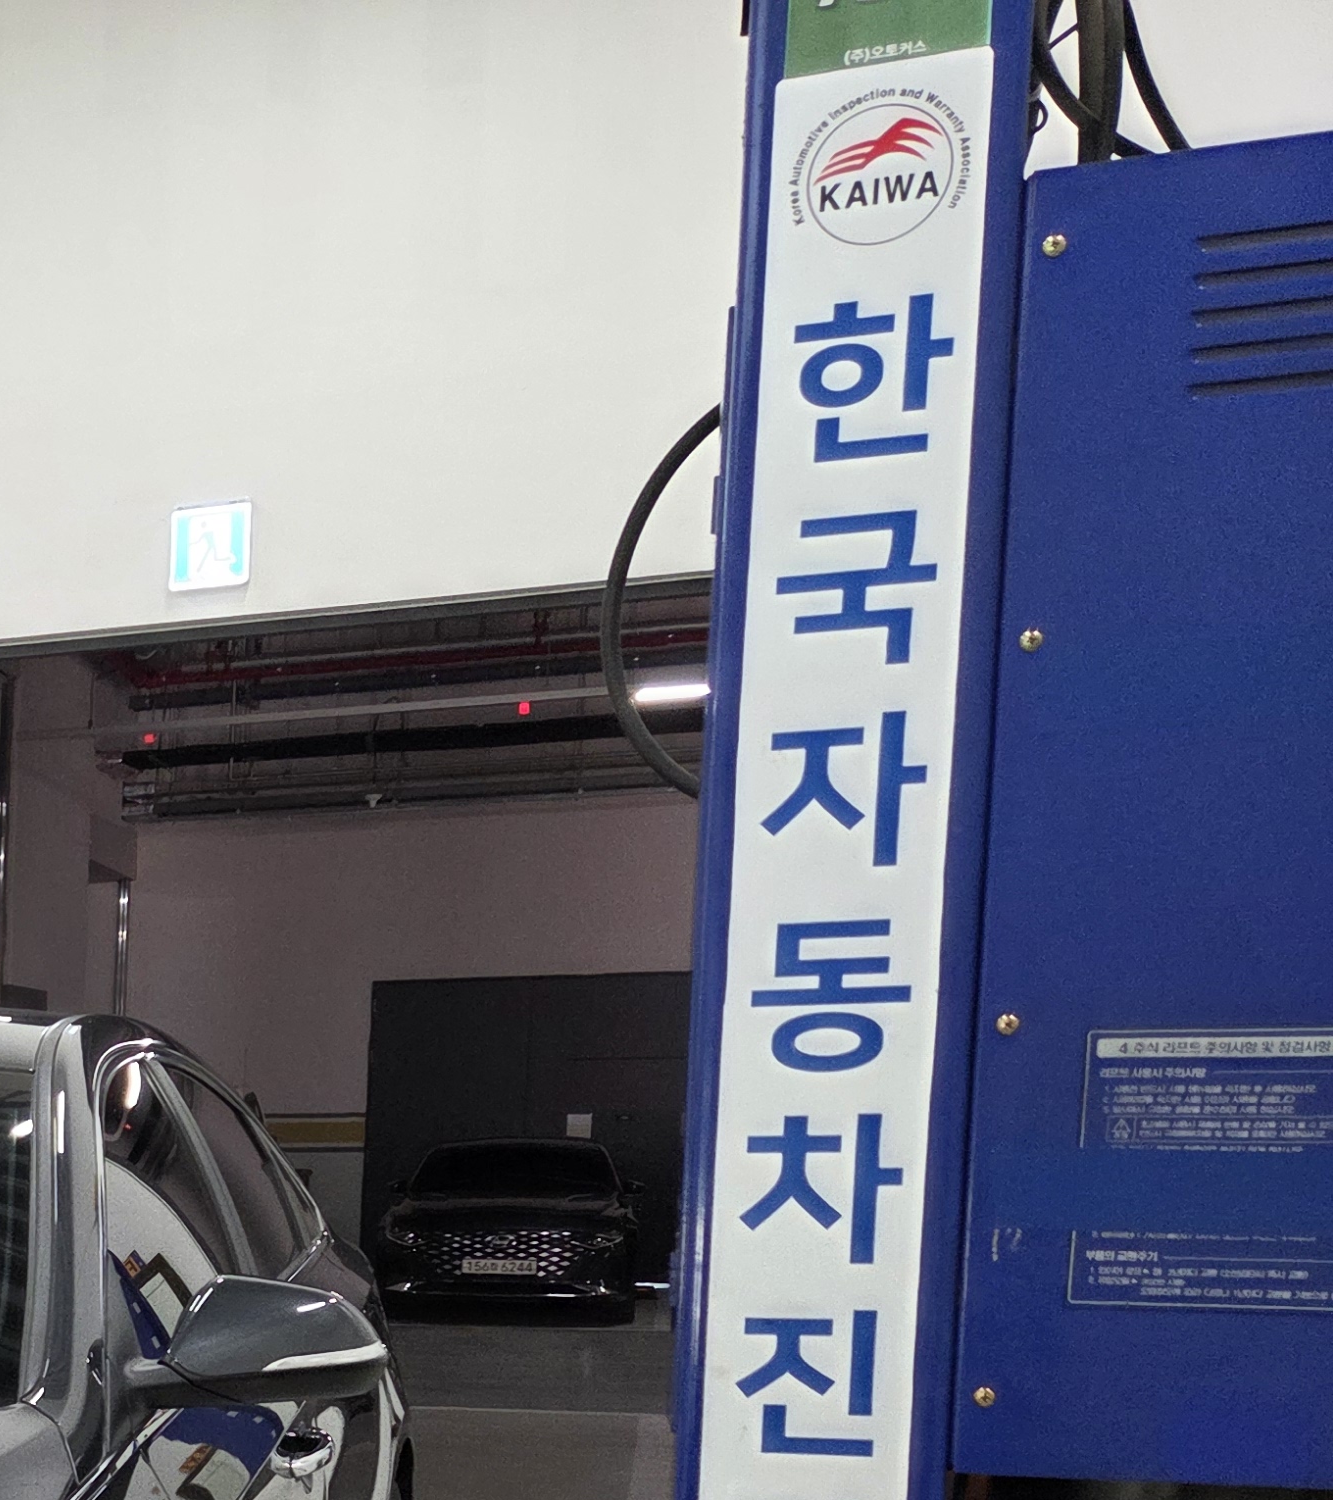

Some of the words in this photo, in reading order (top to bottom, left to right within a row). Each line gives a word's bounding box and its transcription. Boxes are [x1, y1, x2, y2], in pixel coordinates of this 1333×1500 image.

[843, 40, 927, 66] (주)오토커스
[827, 87, 896, 122] Inspection
[899, 87, 924, 100] and
[925, 91, 966, 135] Warranty
[788, 120, 830, 187] Automotive
[947, 136, 972, 210] Association
[790, 191, 806, 227] Korea
[819, 170, 940, 213] KAIWA
[500, 1261, 533, 1273] 6244
